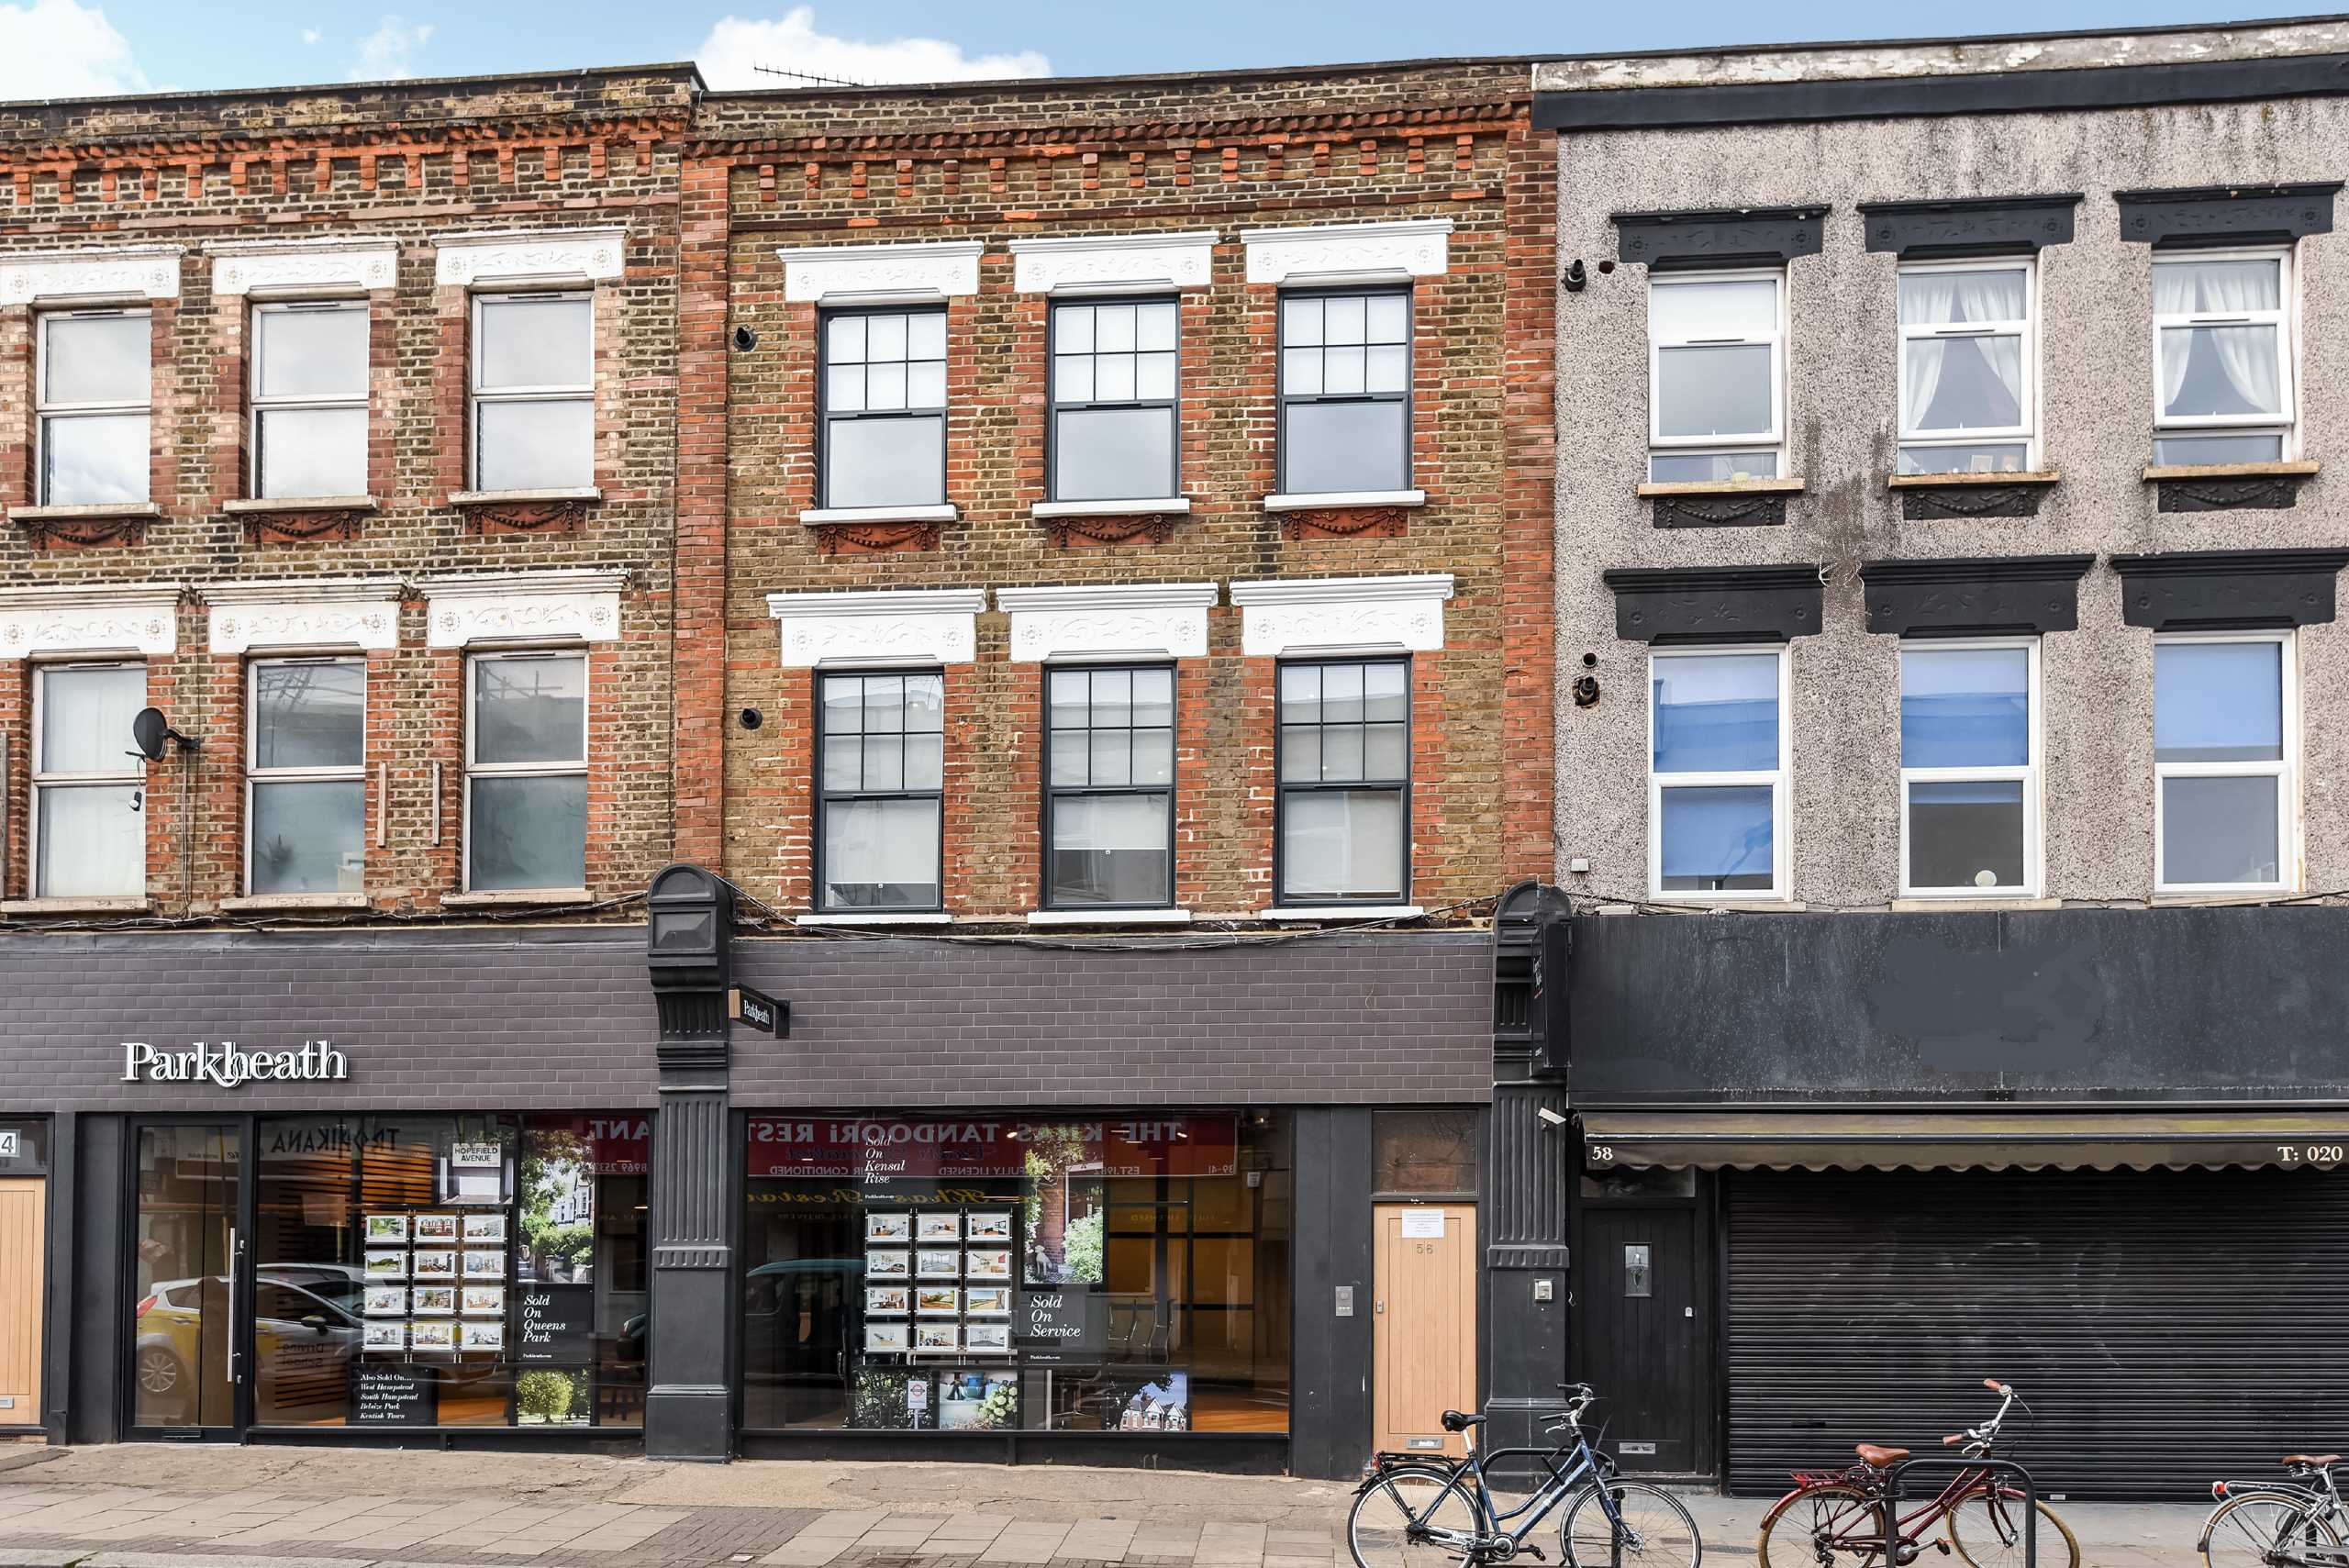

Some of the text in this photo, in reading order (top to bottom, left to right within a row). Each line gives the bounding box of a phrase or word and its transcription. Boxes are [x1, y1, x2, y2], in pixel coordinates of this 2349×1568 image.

[743, 999, 770, 1025] Parkheath
[120, 1040, 349, 1088] Parkheath
[1, 1135, 14, 1153] 4
[865, 1135, 892, 1146] Sold
[865, 1147, 883, 1159] On
[1592, 1146, 1613, 1161] 58
[2277, 1145, 2343, 1162] T: 020
[864, 1160, 906, 1172] Kensal
[864, 1173, 890, 1184] Rise
[1416, 1243, 1433, 1255] 56
[523, 1295, 551, 1306] Sold
[1030, 1295, 1063, 1308] Sold
[524, 1307, 542, 1318] On
[1031, 1308, 1053, 1322] On
[524, 1318, 566, 1331] Queens
[1030, 1323, 1081, 1337] Service
[522, 1330, 551, 1343] Park
[377, 1383, 414, 1392] Hampstead
[382, 1393, 419, 1402] Hampstead
